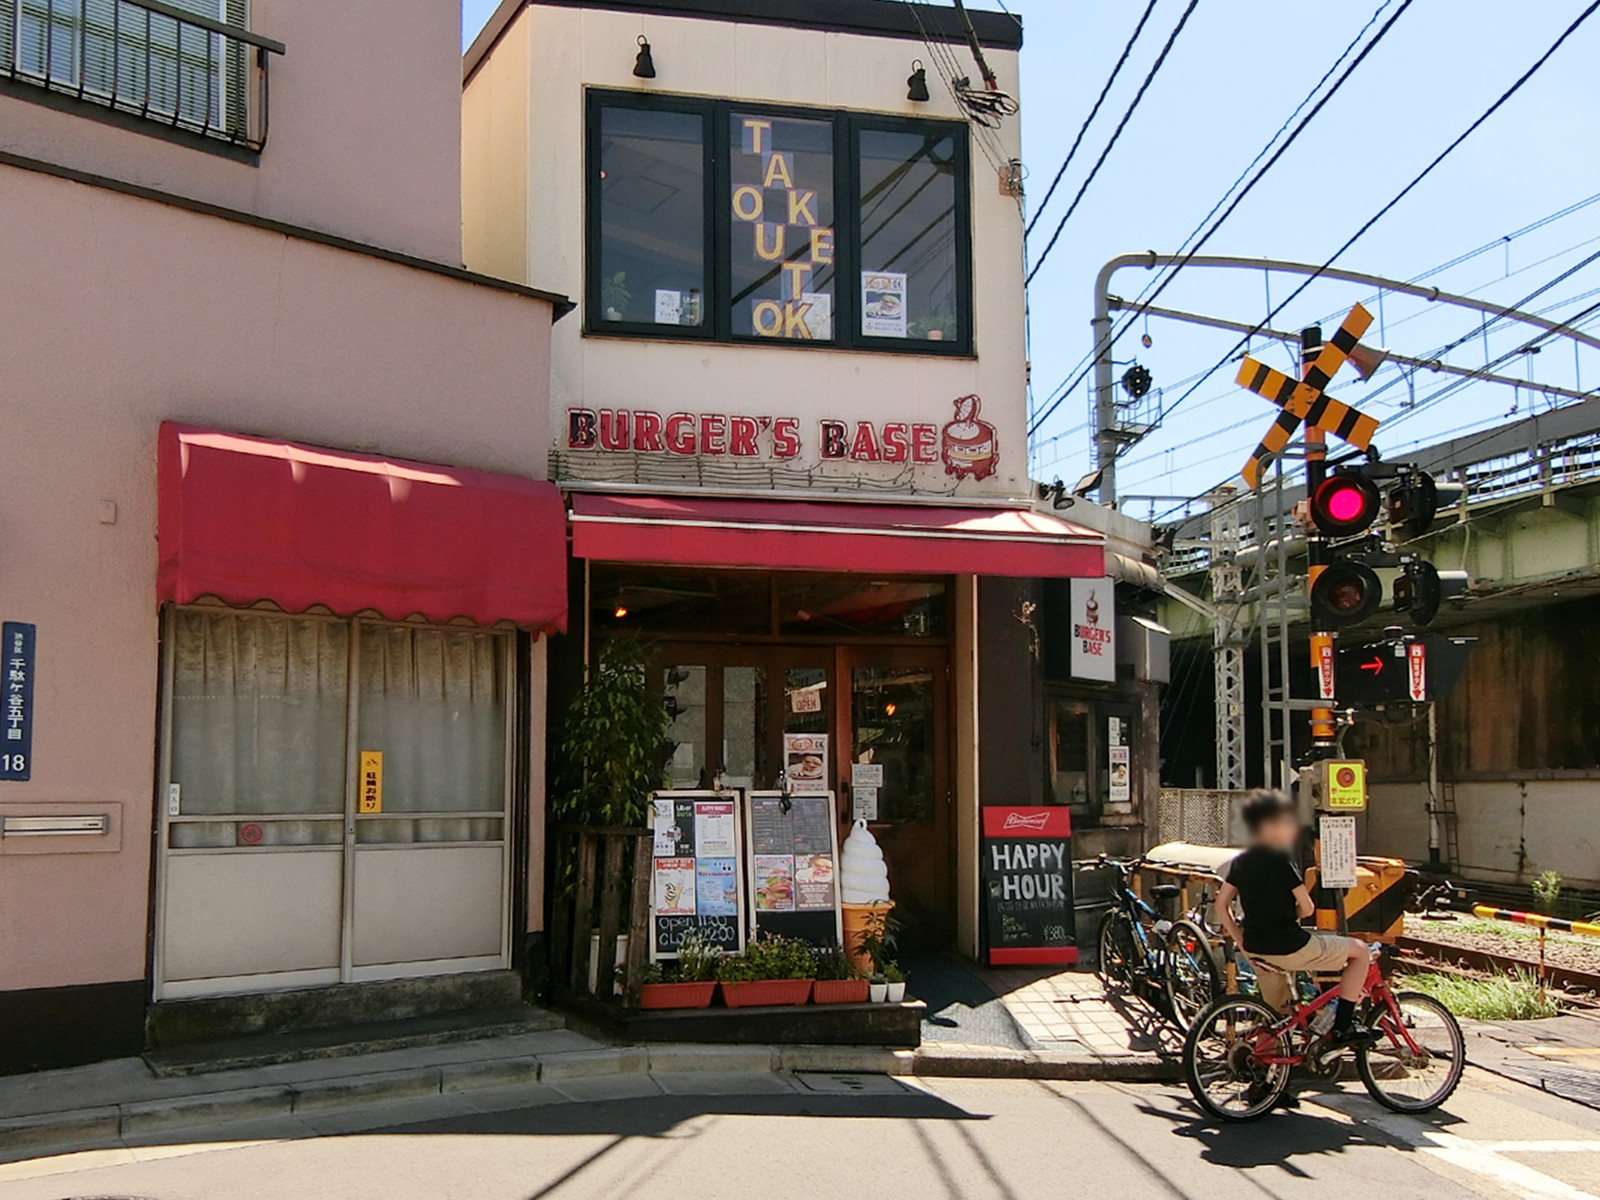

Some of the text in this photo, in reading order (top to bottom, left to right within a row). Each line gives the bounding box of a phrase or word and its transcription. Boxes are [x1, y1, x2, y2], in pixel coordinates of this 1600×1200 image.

[752, 299, 812, 339] OK
[567, 407, 938, 466] BURGER'S BASE
[1074, 624, 1111, 644] BURGER'S
[1083, 640, 1103, 656] BASE
[796, 700, 817, 711] OPEN
[2, 754, 25, 772] 18
[991, 843, 1065, 871] HAPPY
[1003, 873, 1065, 900] HOUR
